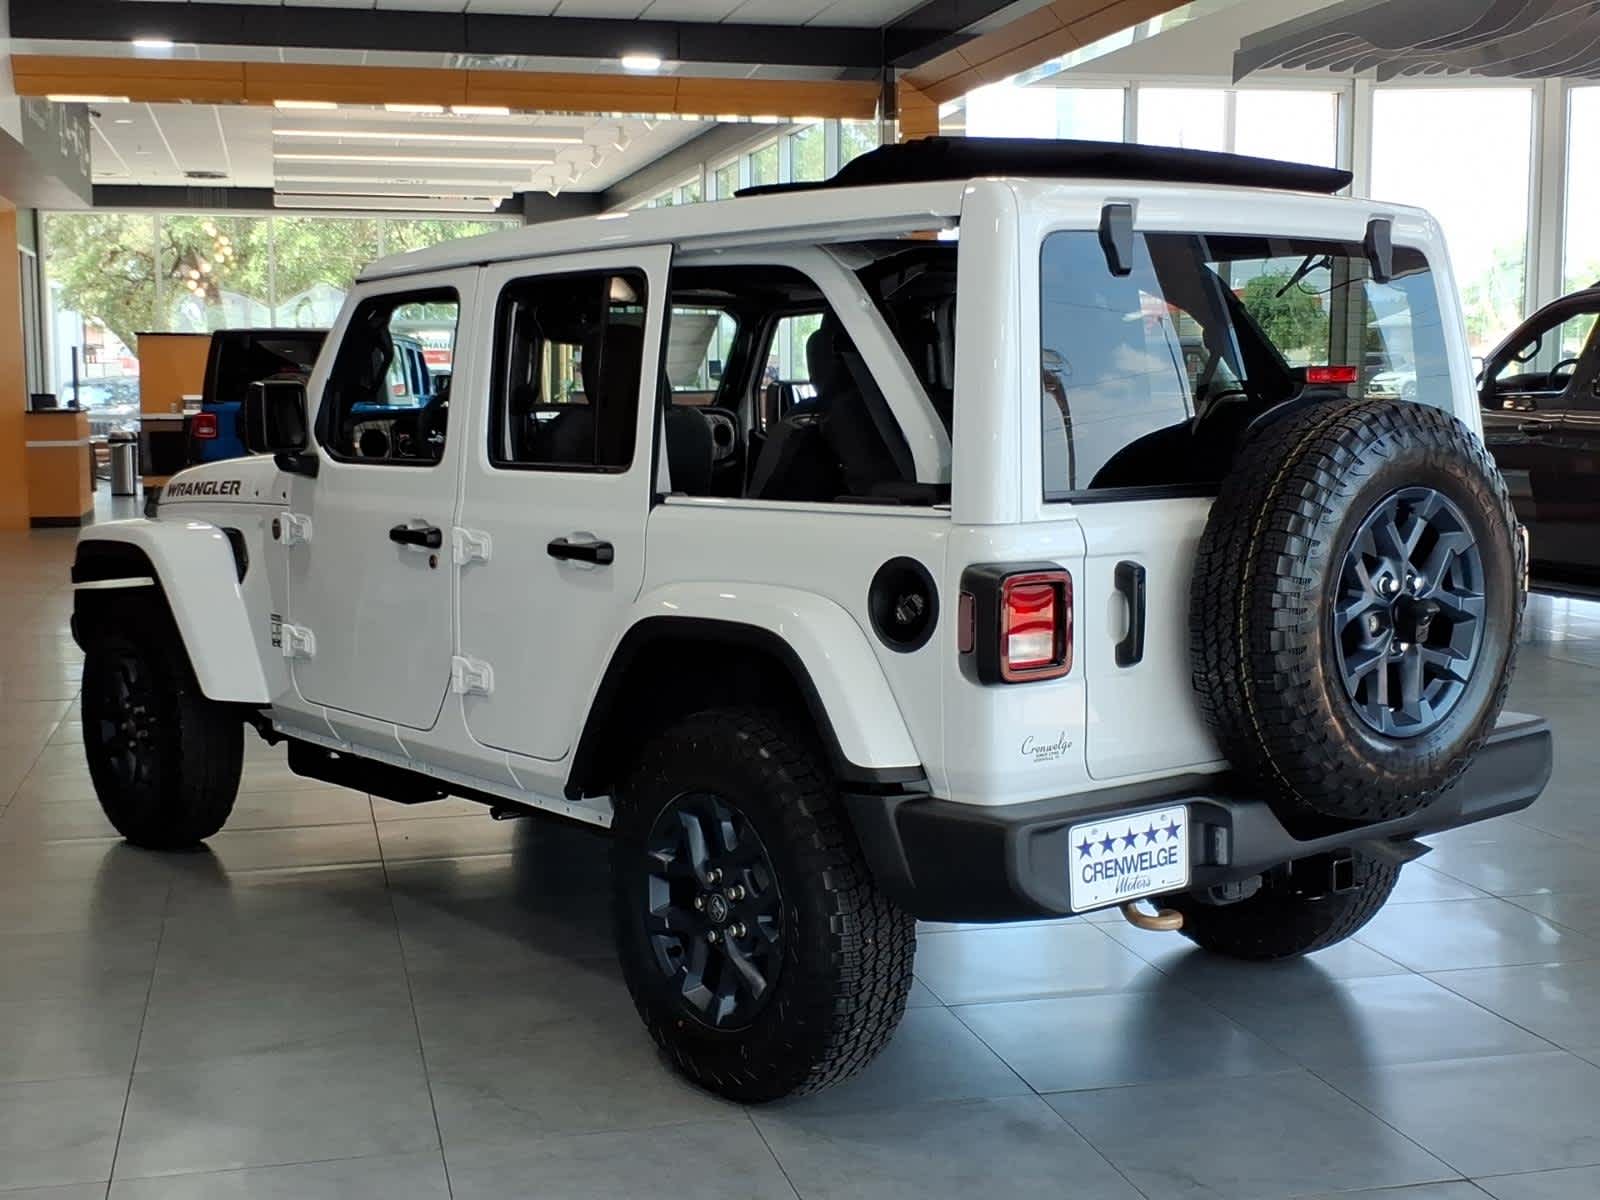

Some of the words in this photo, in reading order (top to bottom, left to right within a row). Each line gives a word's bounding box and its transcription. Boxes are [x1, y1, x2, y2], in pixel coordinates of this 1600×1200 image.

[167, 480, 241, 497] WRANGLER
[1021, 730, 1073, 755] Crenwelge
[1082, 845, 1178, 884] CRENWELGE
[1115, 874, 1151, 894] Motors
